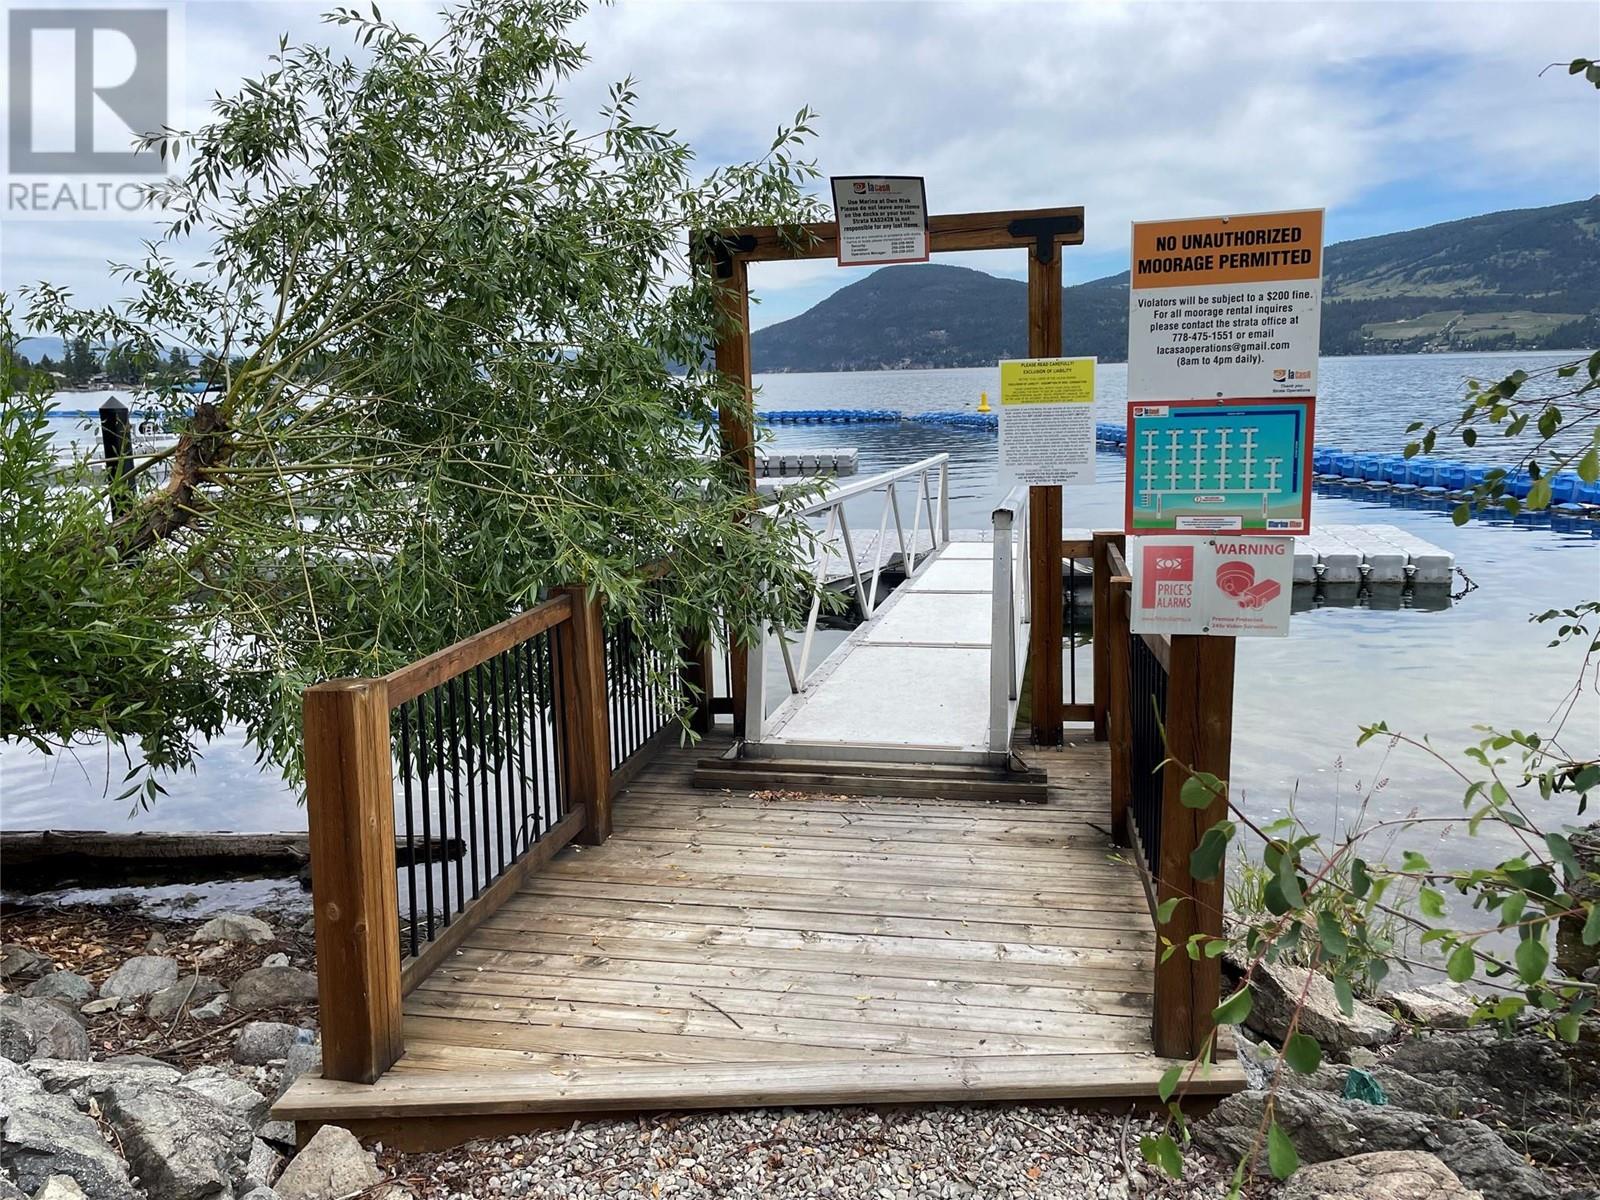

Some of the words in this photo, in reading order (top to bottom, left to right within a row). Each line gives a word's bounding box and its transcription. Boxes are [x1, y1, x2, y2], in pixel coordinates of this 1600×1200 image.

[1156, 236, 1176, 251] NO
[1182, 227, 1301, 250] UNAUTHORIZED
[1138, 255, 1214, 274] MOORAGE
[1219, 249, 1312, 269] PERMITTED
[1138, 298, 1177, 308] Violators
[1179, 296, 1195, 305] will
[1198, 295, 1209, 304] be
[1212, 292, 1244, 307] subject
[1247, 292, 1255, 302] to
[1266, 290, 1289, 301] $200
[1292, 290, 1313, 300] fine.
[1154, 310, 1167, 319] For
[1170, 309, 1181, 318] all
[1184, 309, 1223, 320] moorage
[1226, 305, 1252, 316] rental
[1255, 304, 1293, 316] inquires
[1150, 322, 1179, 332] please
[1181, 319, 1214, 330] contact
[1216, 318, 1230, 328] the
[1233, 317, 1258, 327] strata
[1262, 316, 1287, 326] office
[1289, 316, 1298, 324] at
[1172, 332, 1233, 343] 778-475-1551
[1248, 329, 1274, 338] email
[1156, 341, 1290, 355] lacasaoperations@gmail.com
[1177, 356, 1199, 368] (8am
[1202, 356, 1210, 364] to
[1213, 355, 1232, 366] 4pm
[1235, 354, 1264, 365] daily).
[1215, 544, 1285, 555] WARNING
[1158, 584, 1192, 595] PRICE'S
[1157, 598, 1191, 608] ALARMS
